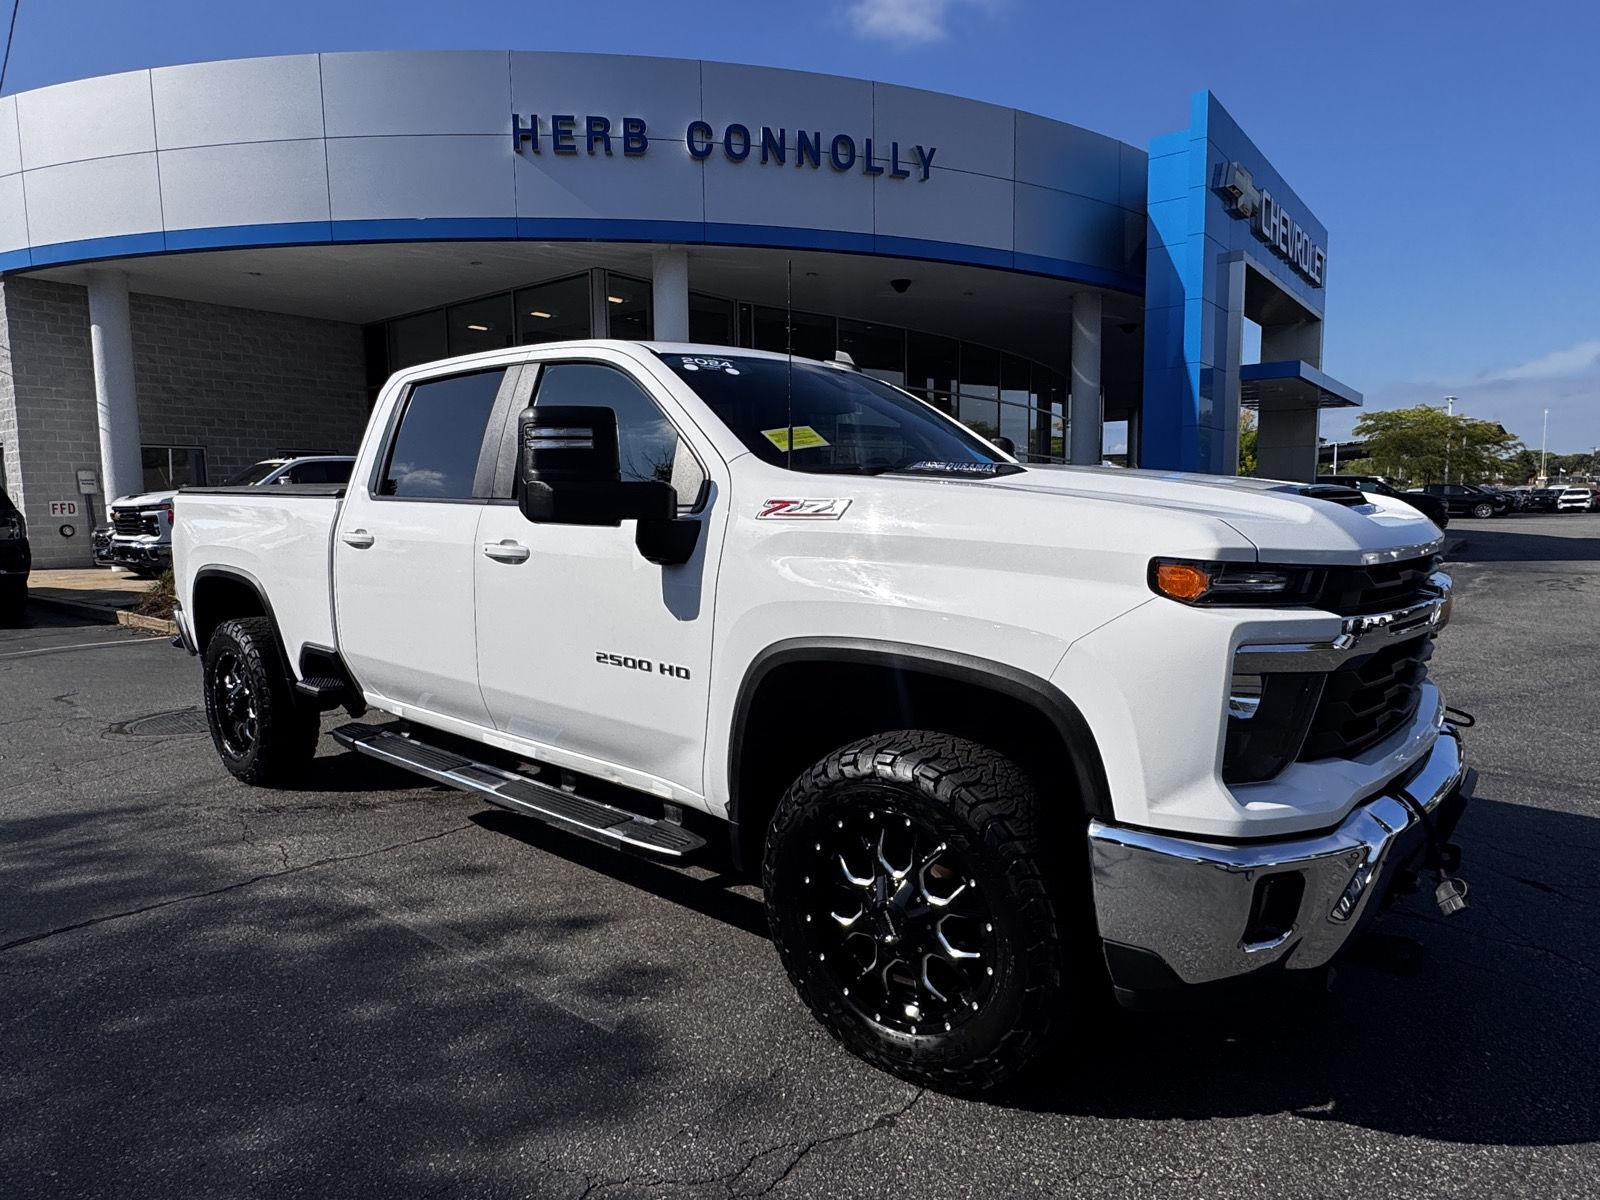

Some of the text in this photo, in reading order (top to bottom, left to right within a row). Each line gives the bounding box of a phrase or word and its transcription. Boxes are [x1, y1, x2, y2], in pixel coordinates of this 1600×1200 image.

[512, 113, 937, 181] HERB CONNOLLY
[1260, 187, 1326, 288] CHEVROLET
[51, 502, 76, 515] FFD
[755, 498, 853, 520] Z71
[595, 651, 691, 681] 2500 HD
